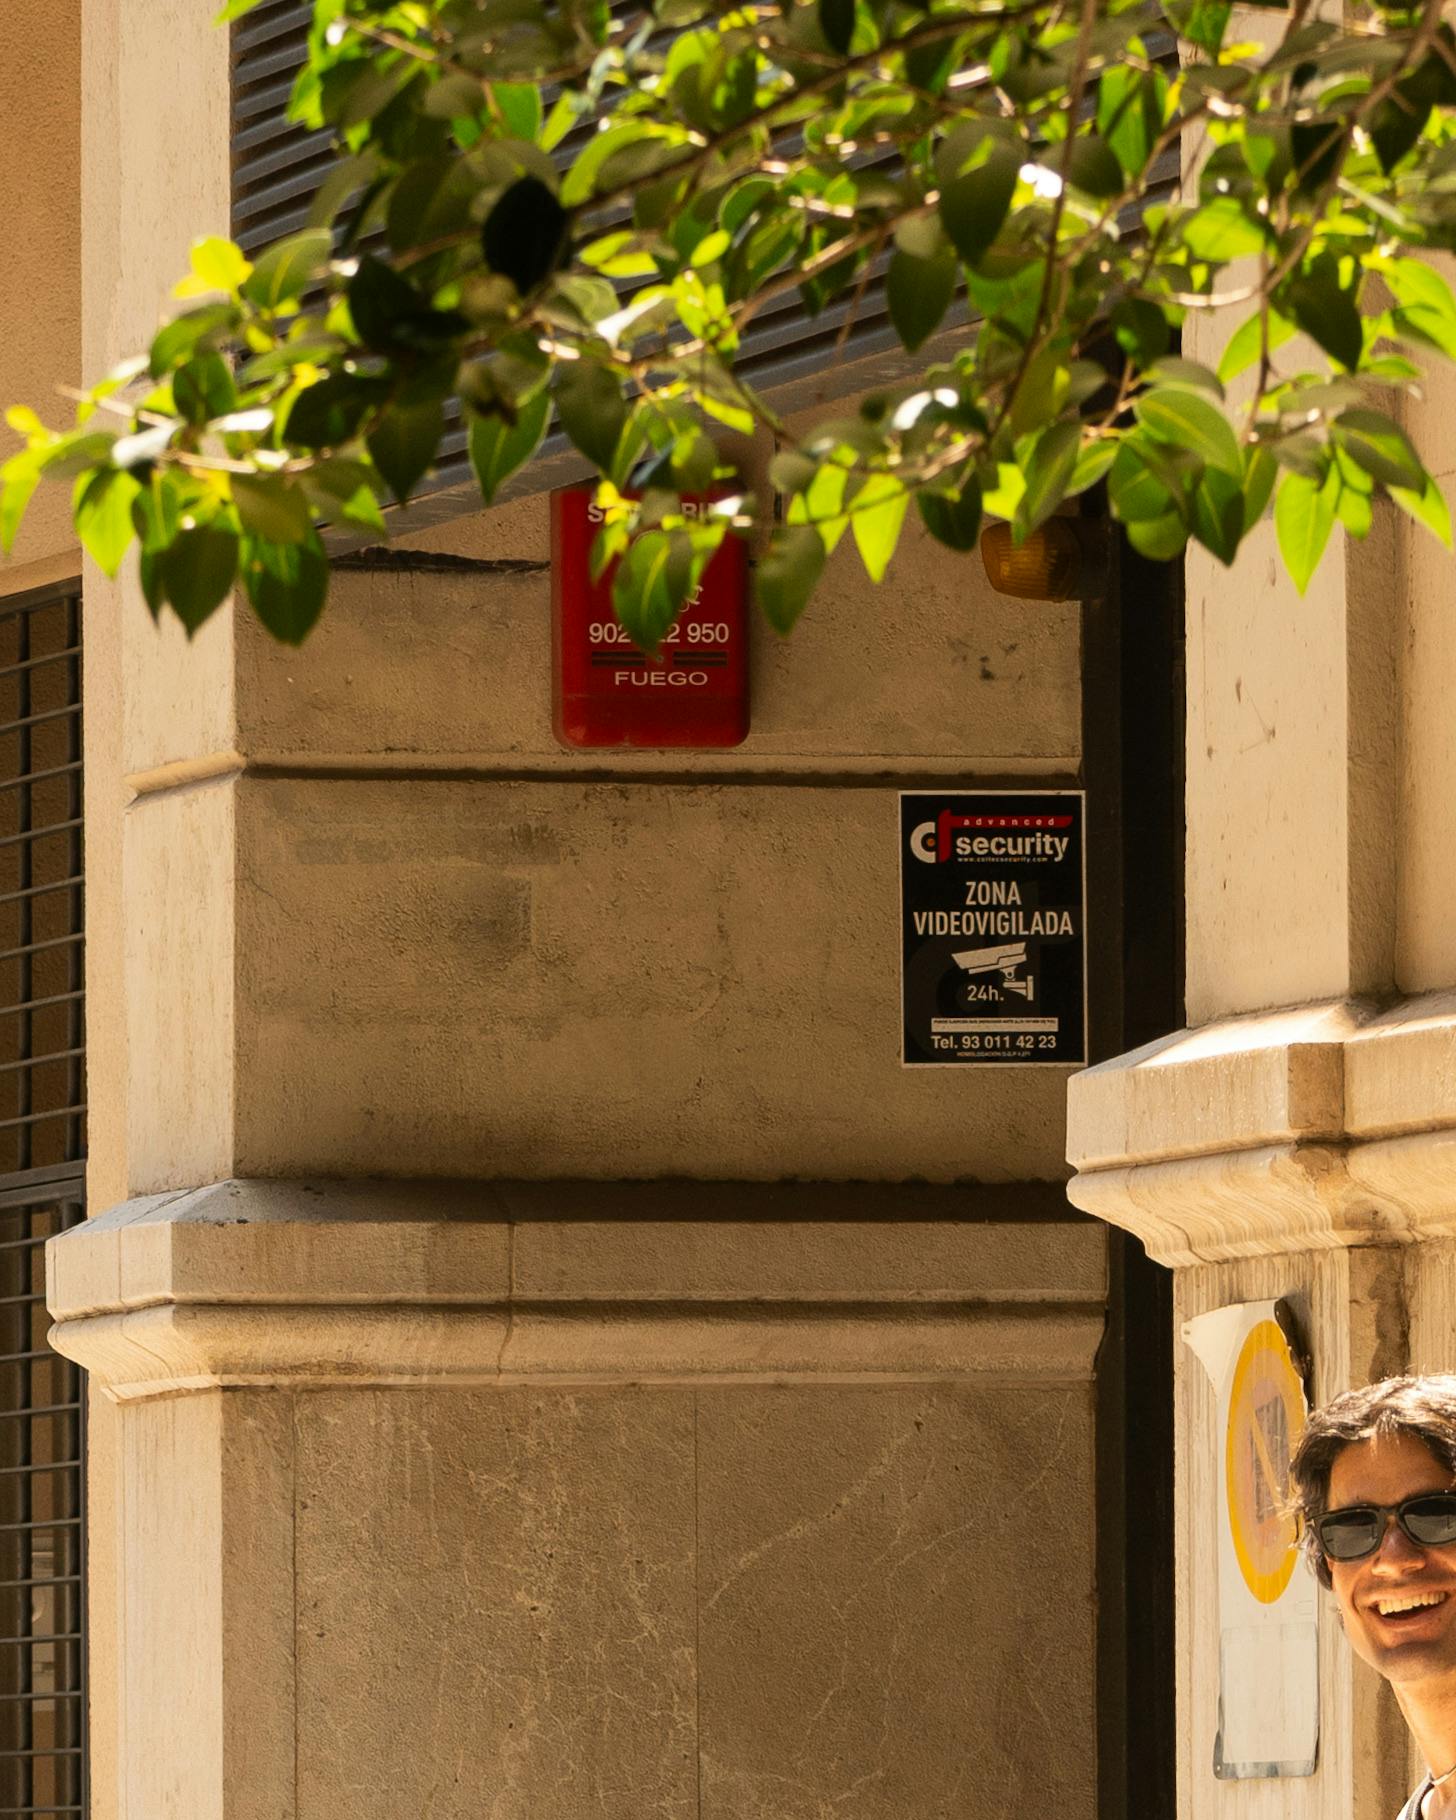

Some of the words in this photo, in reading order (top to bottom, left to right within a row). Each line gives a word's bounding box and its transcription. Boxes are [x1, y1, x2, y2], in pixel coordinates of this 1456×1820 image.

[686, 623, 729, 643] 950
[614, 671, 708, 686] FUEGO
[963, 818, 1055, 826] advanced
[956, 832, 1069, 862] security
[965, 881, 1022, 905] ZONA
[913, 911, 1074, 935] VIDEOVIGILADA
[967, 985, 1004, 1001] 24h.
[931, 1035, 958, 1048] Tel.
[962, 1035, 980, 1049] 93
[984, 1035, 1010, 1048] 011
[1016, 1035, 1034, 1048] 42
[1038, 1035, 1057, 1049] 23
